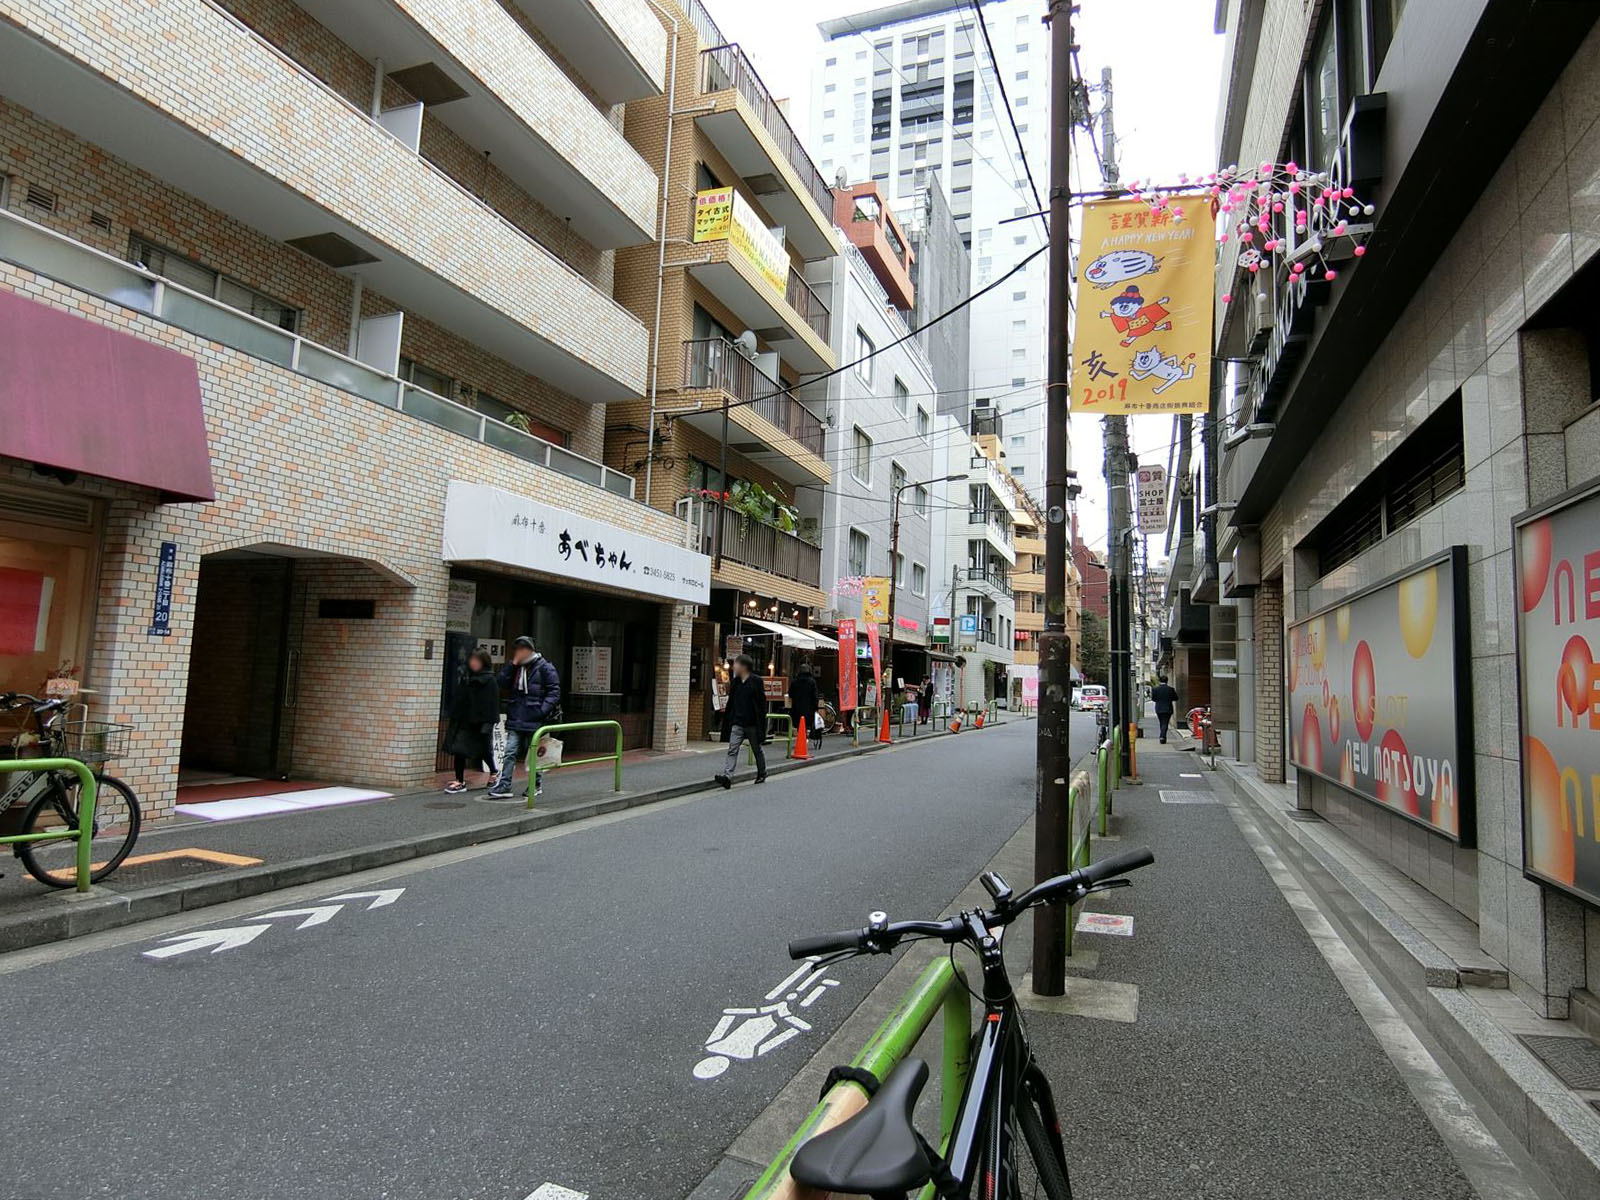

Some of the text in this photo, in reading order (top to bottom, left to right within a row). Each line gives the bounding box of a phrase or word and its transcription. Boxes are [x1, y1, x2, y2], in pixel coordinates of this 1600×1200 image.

[697, 205, 730, 217] タイ古式
[697, 215, 729, 225] マッサージ
[1110, 232, 1144, 248] HAPPY
[1144, 230, 1166, 244] NEW
[1081, 350, 1118, 381] 亥
[1082, 378, 1129, 406] 2019
[1139, 489, 1164, 498] SHOP
[512, 513, 546, 537] 麻布十番
[682, 577, 704, 588] サッポロビール
[155, 611, 168, 622] 20
[1345, 739, 1369, 776] NEW
